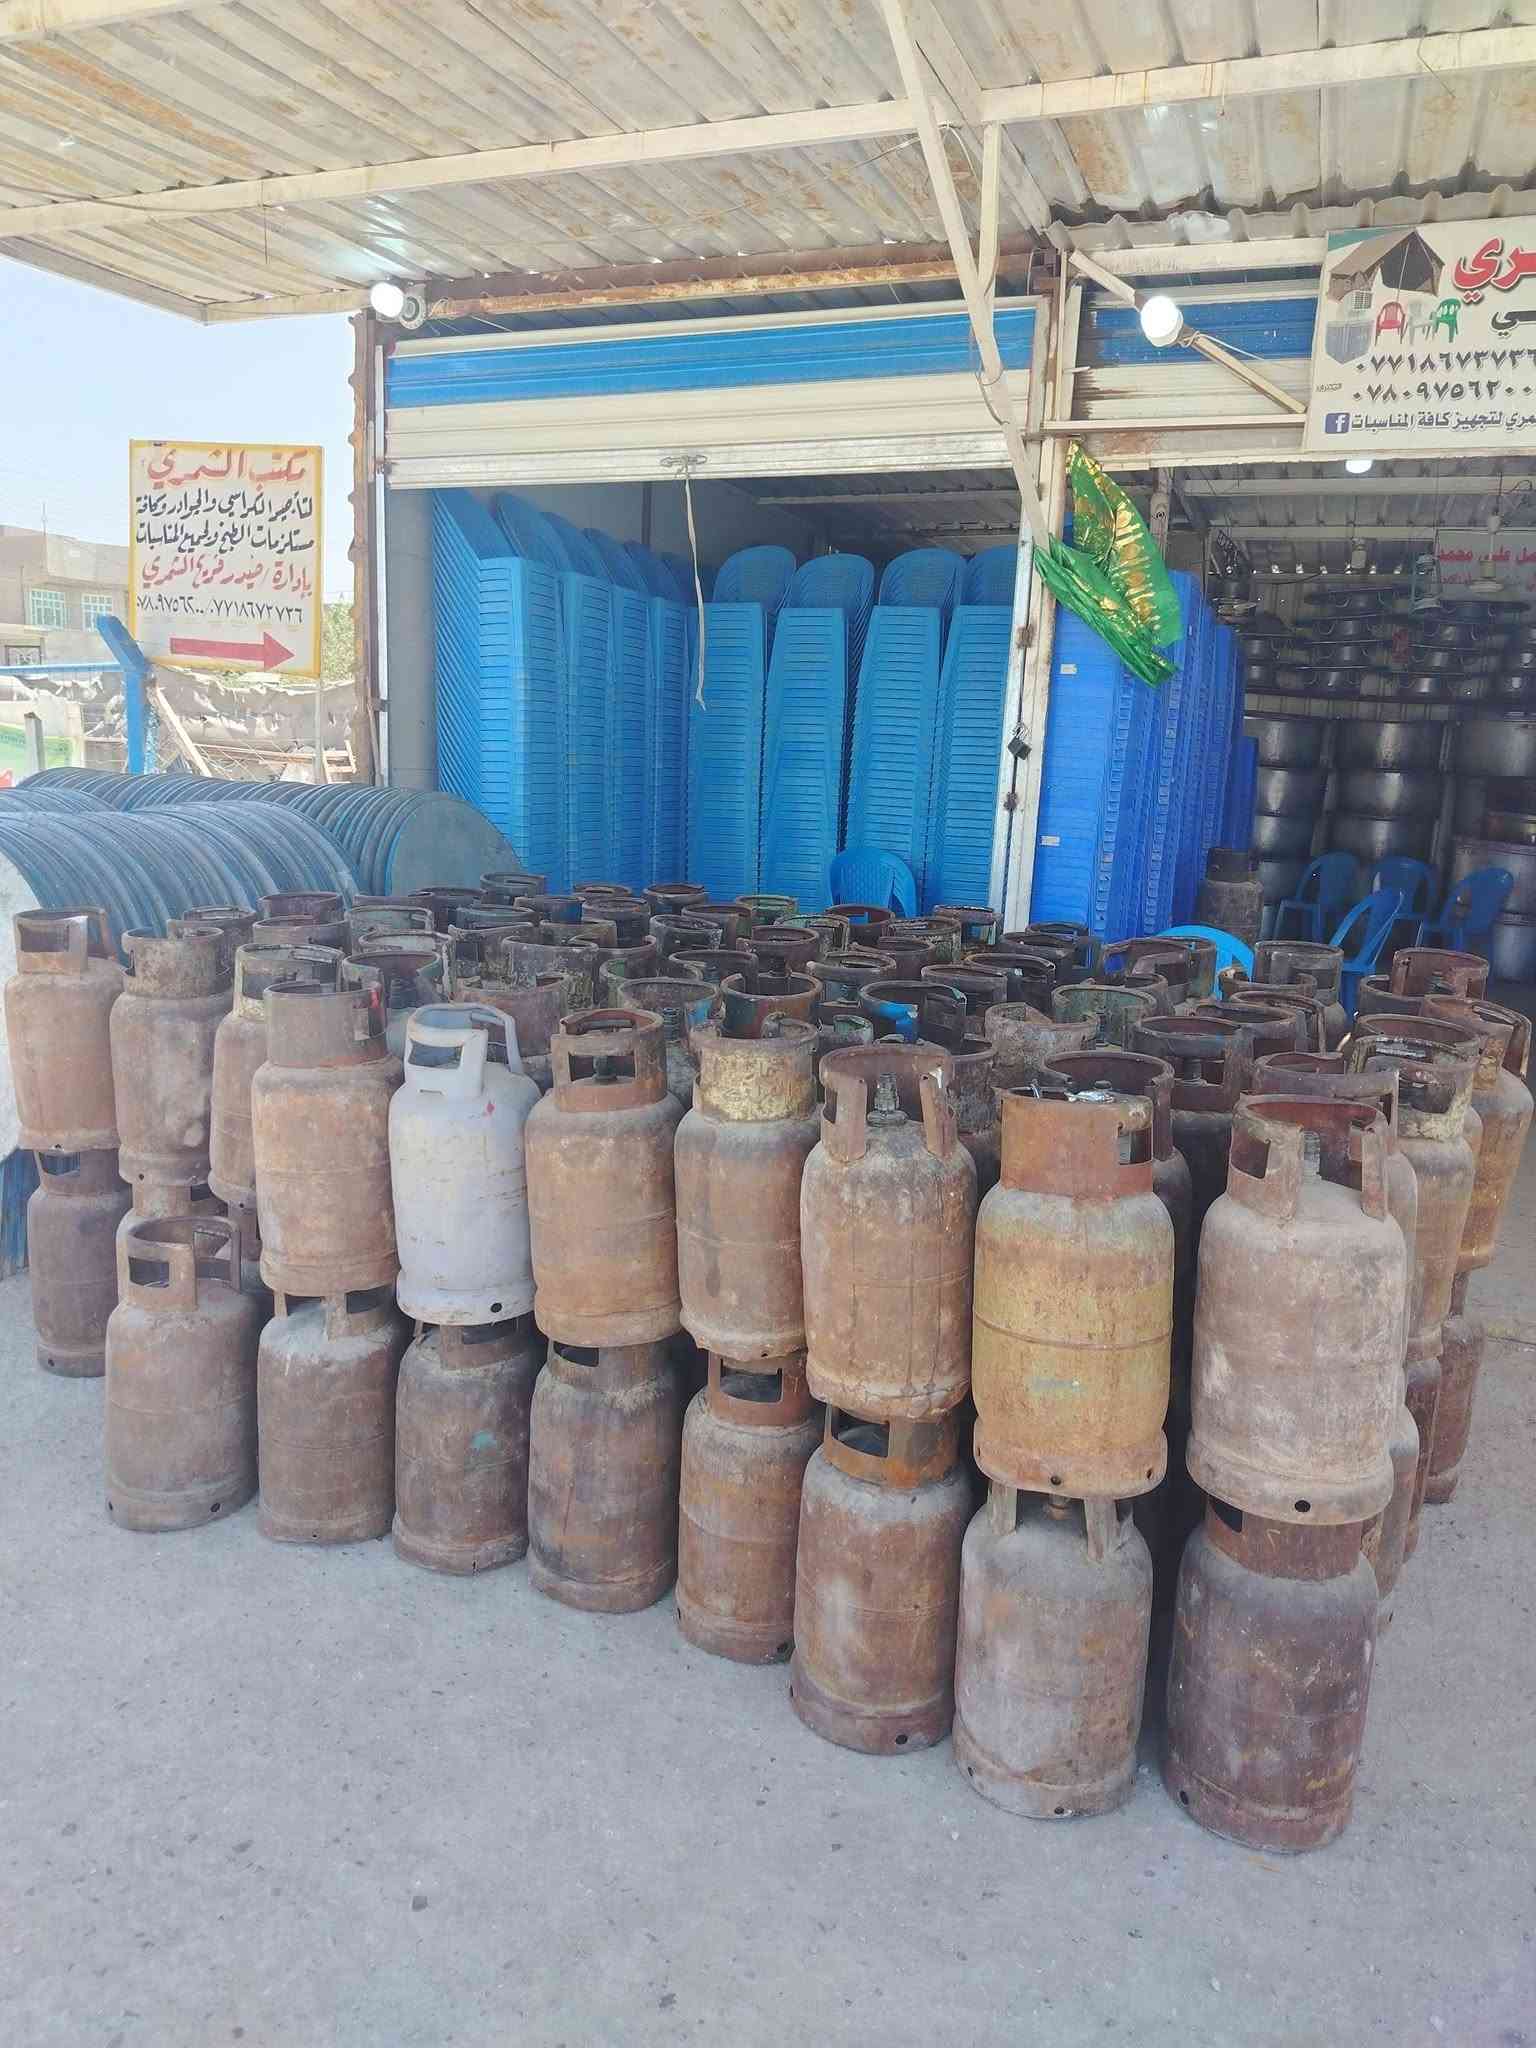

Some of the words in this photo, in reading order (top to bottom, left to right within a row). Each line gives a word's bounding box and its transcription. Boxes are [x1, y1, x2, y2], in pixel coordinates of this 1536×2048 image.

[1352, 380, 1533, 402] ٠٧٨٠٩٧٥٦٢٠٠
[1351, 412, 1414, 432] المناسبات
[1418, 410, 1450, 428] كافة
[1454, 411, 1503, 430] لتجهيز
[147, 448, 245, 490] الشمري
[249, 449, 308, 491] مكتب
[218, 489, 273, 518] الكراسي
[136, 522, 184, 550] المناسبات
[218, 521, 250, 554] الطبخ
[251, 525, 314, 554] مستلزمات
